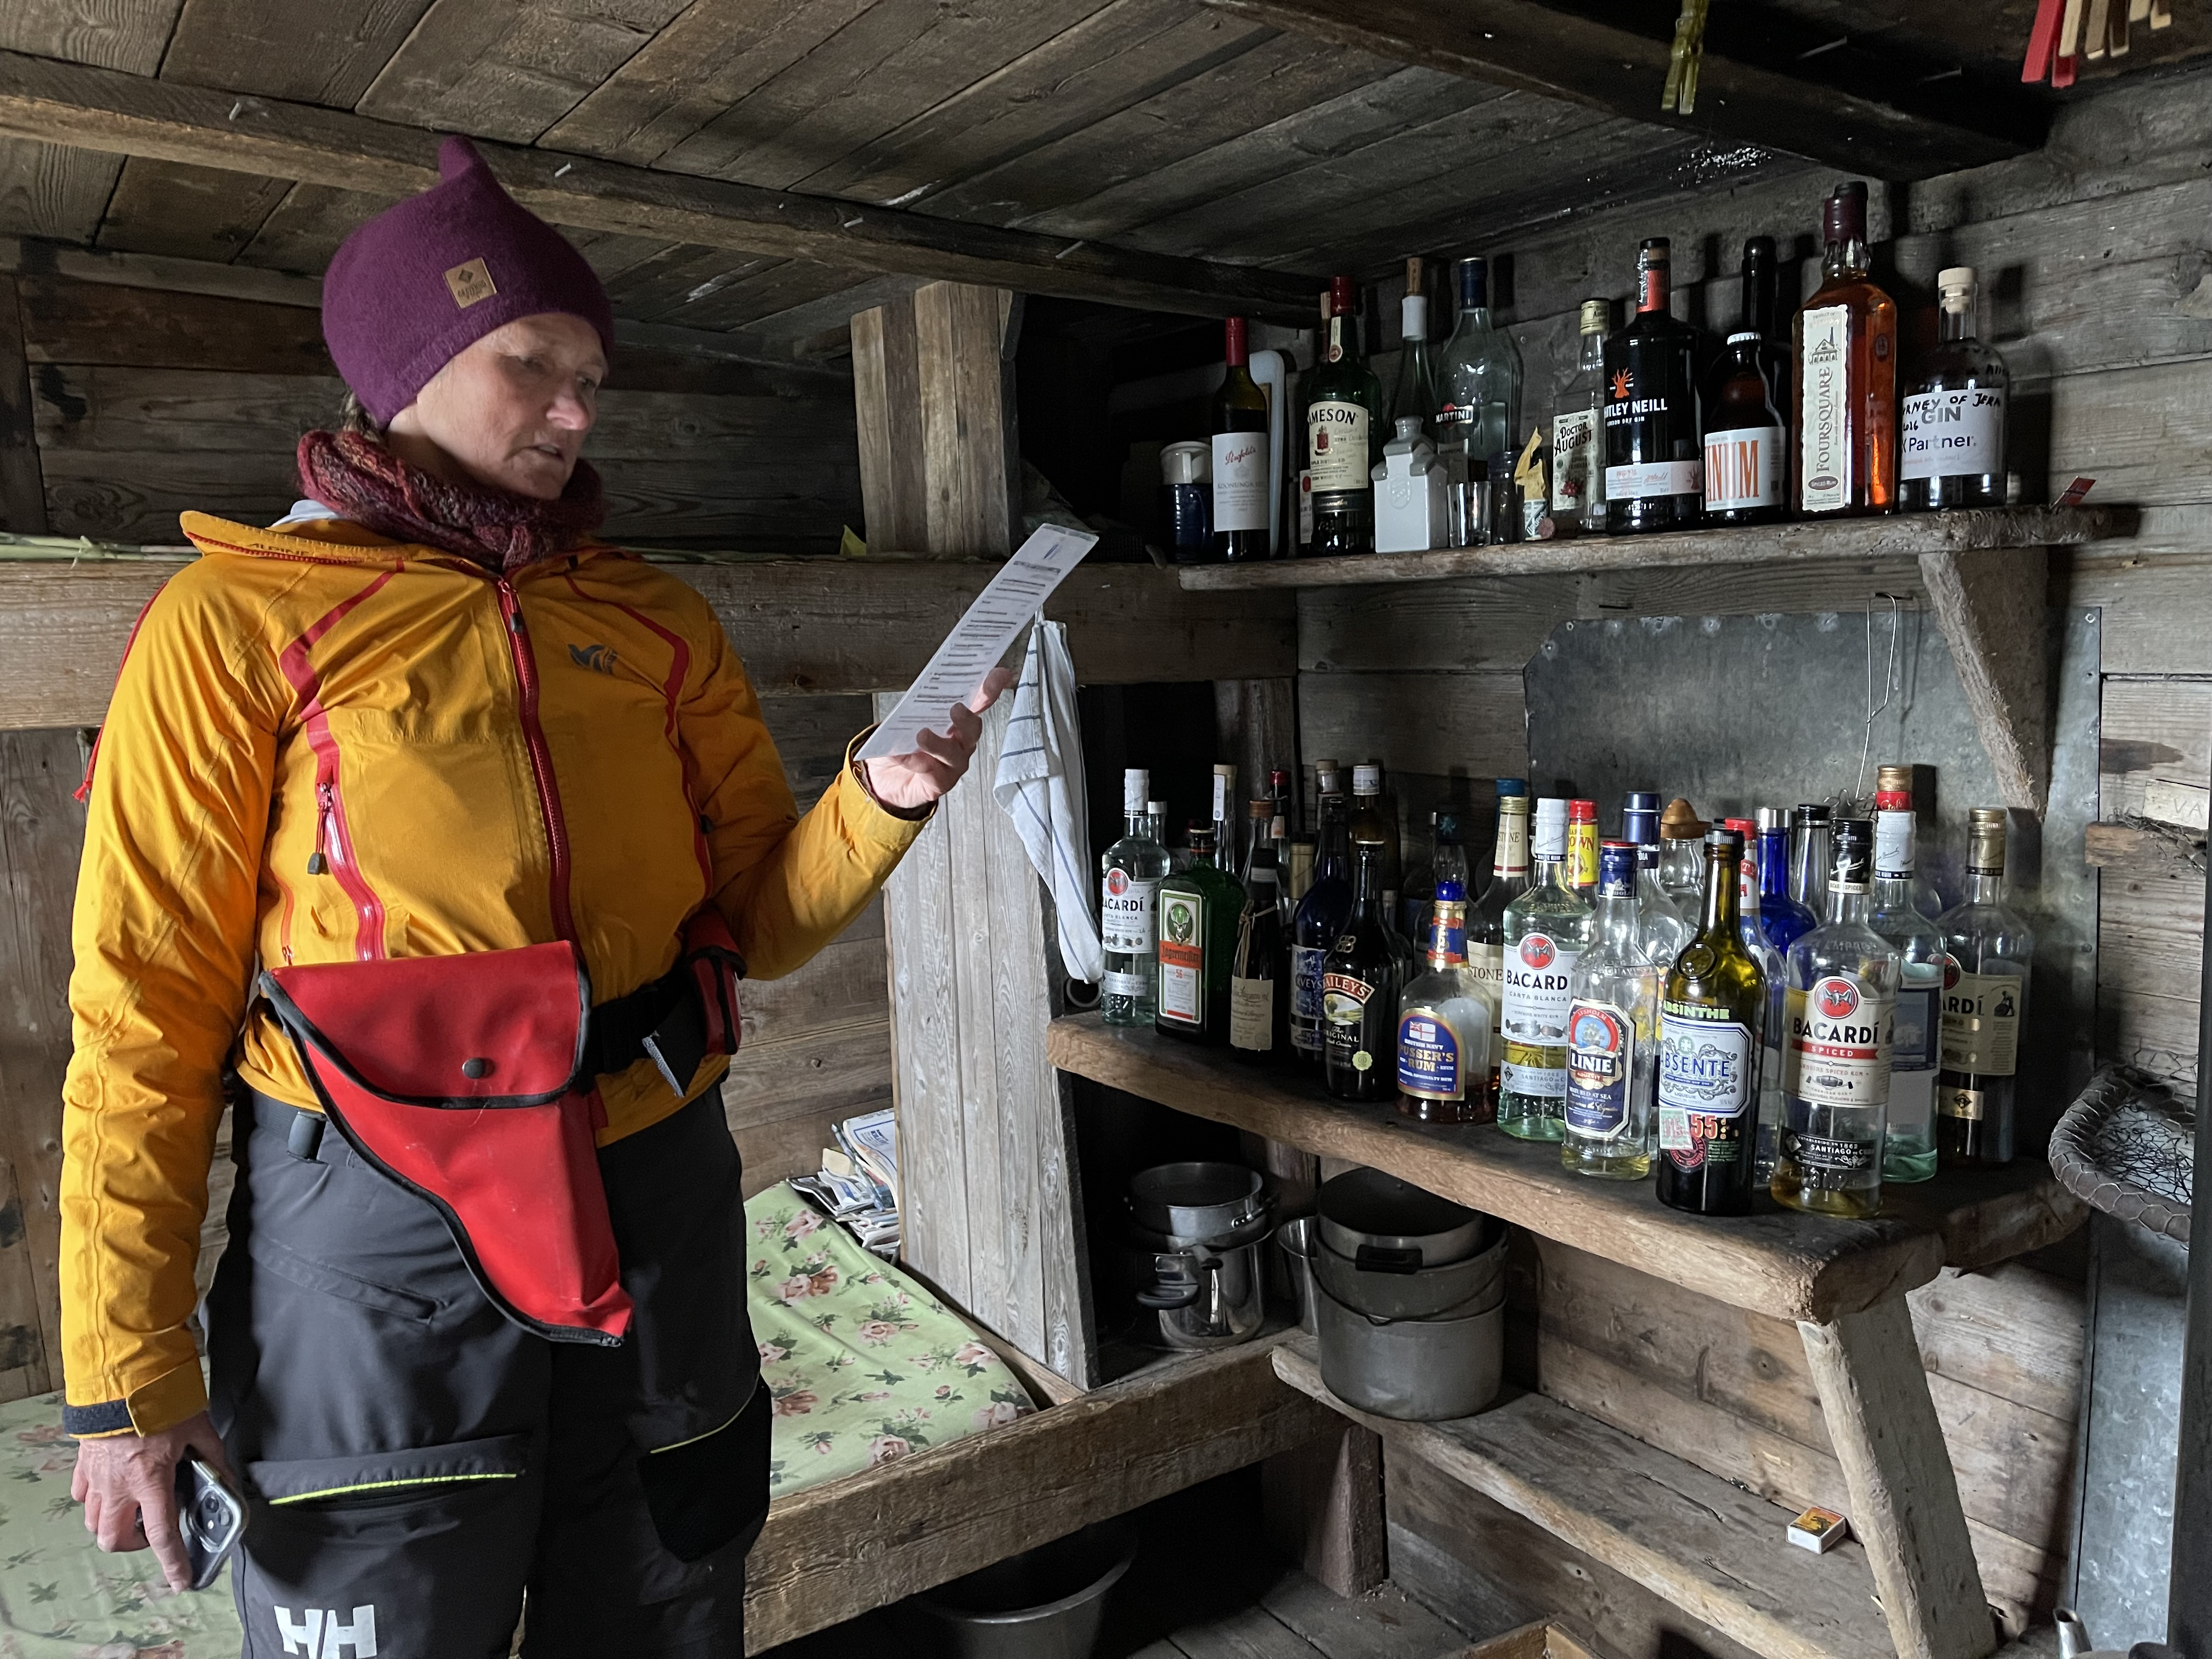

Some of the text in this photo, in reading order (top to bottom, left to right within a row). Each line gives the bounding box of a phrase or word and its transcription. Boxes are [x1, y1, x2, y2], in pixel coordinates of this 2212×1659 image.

[1632, 398, 1667, 414] NEILL
[1950, 396, 1967, 405] OF
[1309, 408, 1356, 426] AMESON
[1436, 410, 1470, 423] MARTINI
[1816, 366, 1833, 473] FOURSQUARE
[1921, 406, 1961, 424] GIN
[1560, 421, 1588, 439] DOCTOR
[1554, 429, 1593, 457] AUGUST
[1103, 896, 1144, 911] ACARDÍ
[1323, 976, 1367, 997] AILEYS
[1507, 969, 1568, 990] BACARD
[1509, 991, 1531, 1000] CARTA
[1325, 1029, 1359, 1042] RIGINAL
[1793, 1017, 1880, 1044] BACARDÍ
[1812, 1045, 1854, 1057] SPICED
[1408, 1058, 1435, 1072] RUM
[1571, 1052, 1612, 1073] LINIE
[1662, 1052, 1730, 1077] BSENTE
[1521, 1074, 1554, 1082] SANTIAGO
[1691, 1113, 1718, 1139] 55
[1810, 1144, 1852, 1155] SANTIAGO
